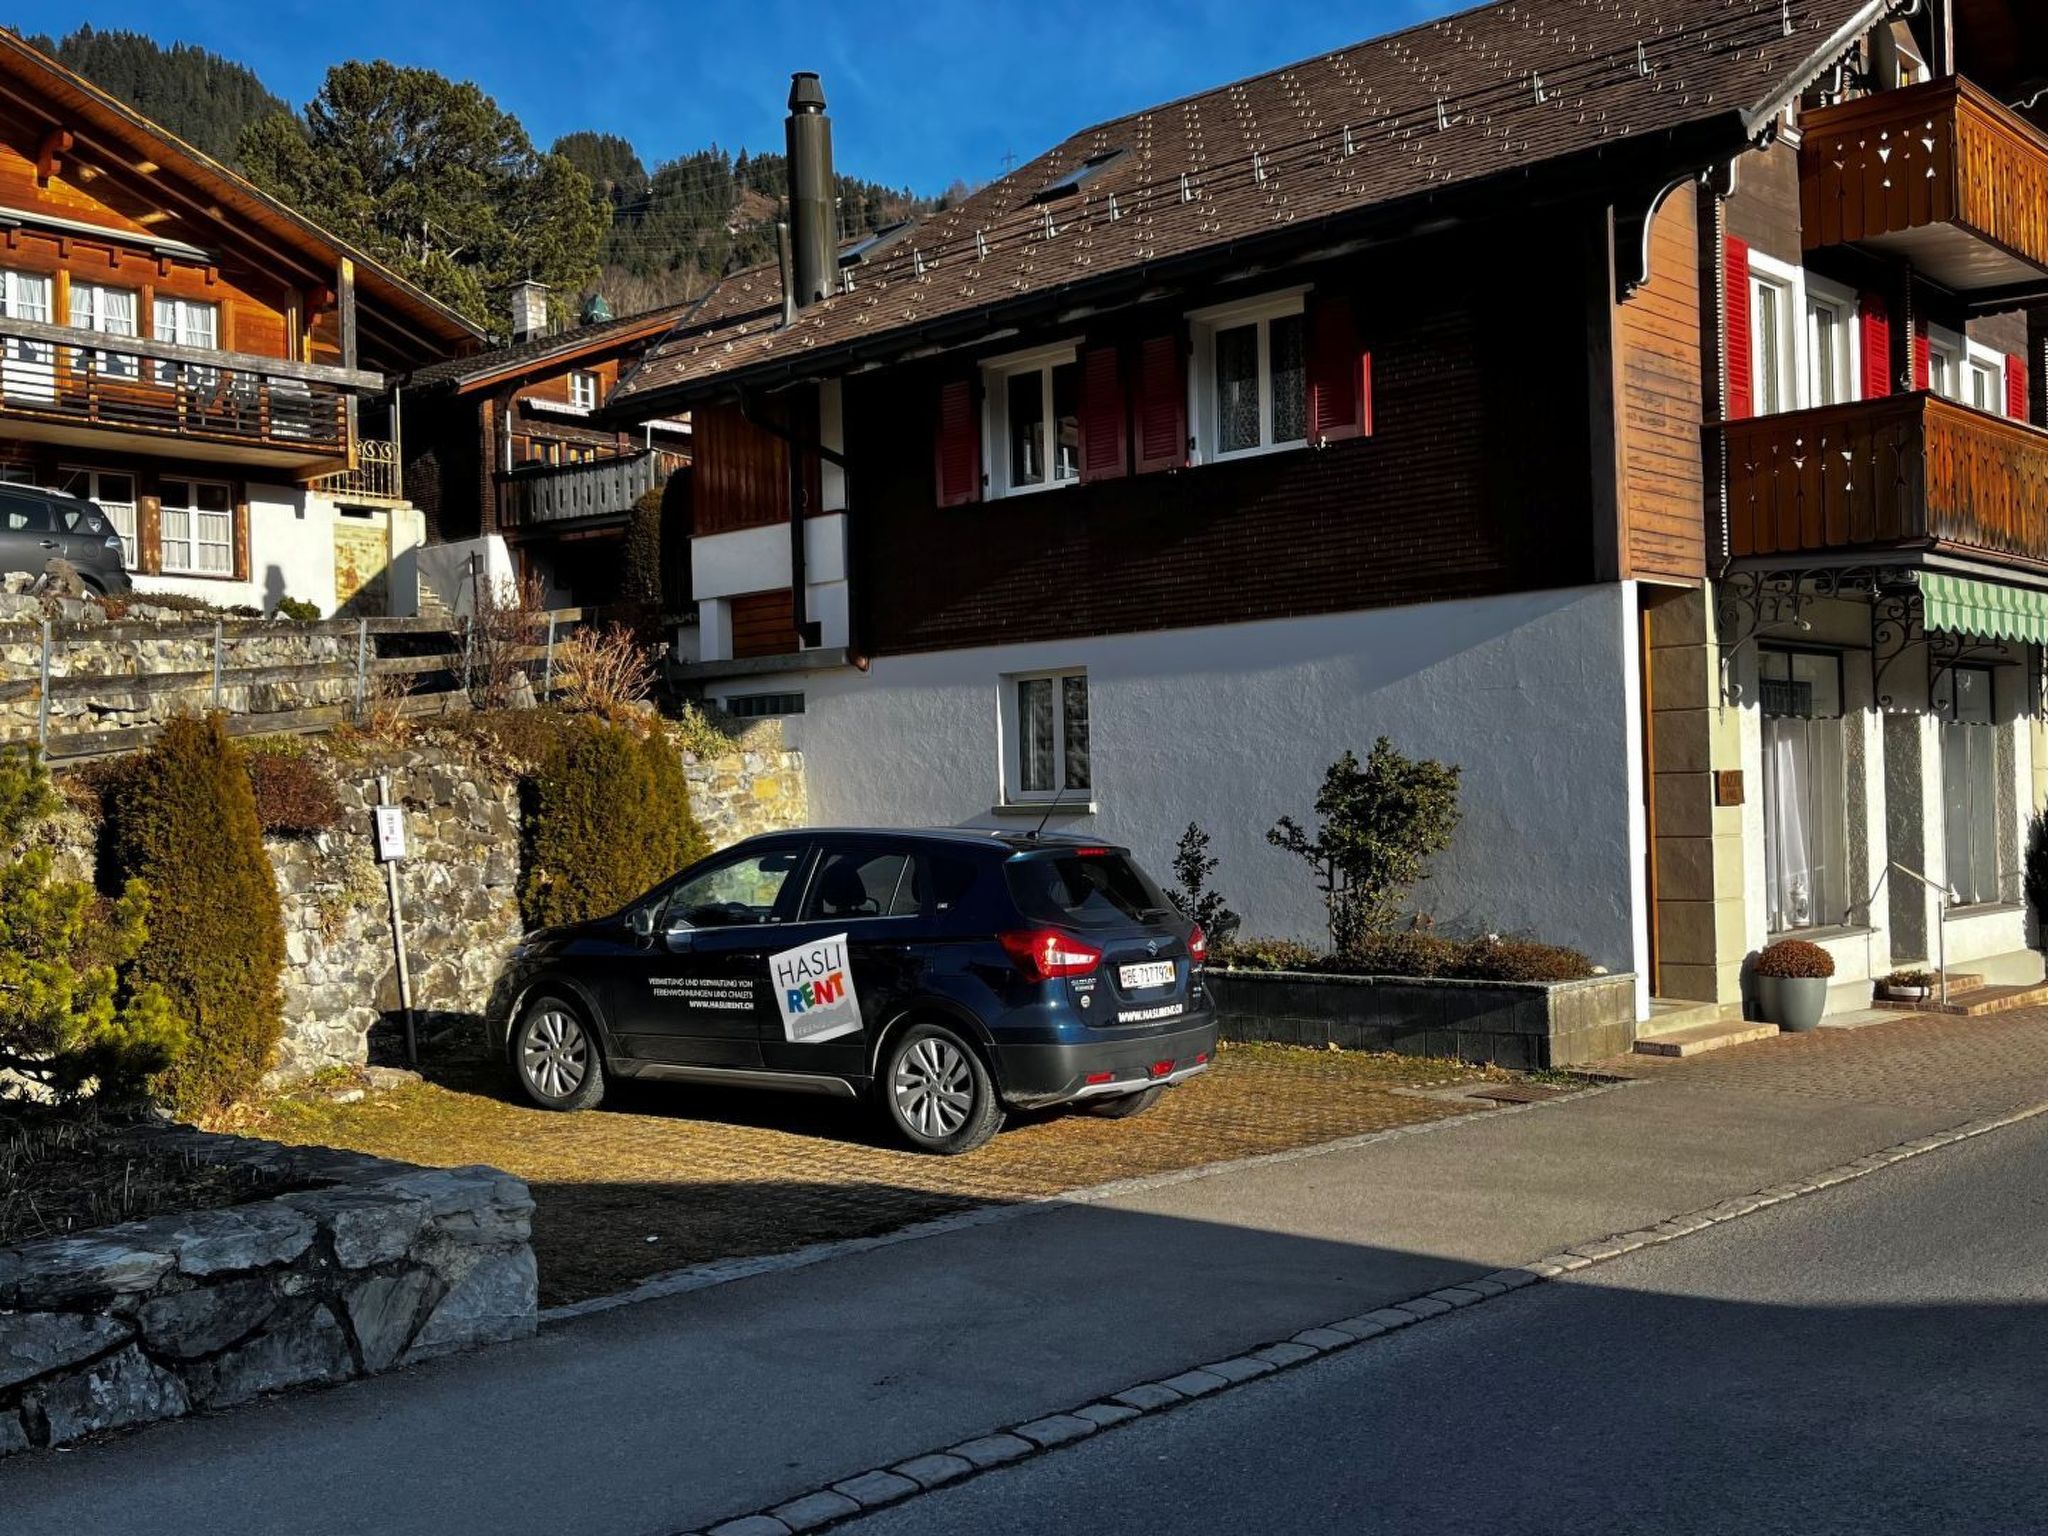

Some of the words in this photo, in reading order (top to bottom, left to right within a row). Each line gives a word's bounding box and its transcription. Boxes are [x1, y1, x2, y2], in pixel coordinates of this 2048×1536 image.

[777, 943, 842, 988] HASLI
[685, 979, 699, 987] UND
[738, 980, 753, 988] VON
[713, 990, 727, 998] UND
[728, 990, 753, 999] CHALETS
[786, 971, 845, 1013] RENT
[689, 1000, 755, 1010] WWW.HASLIRENT.CH
